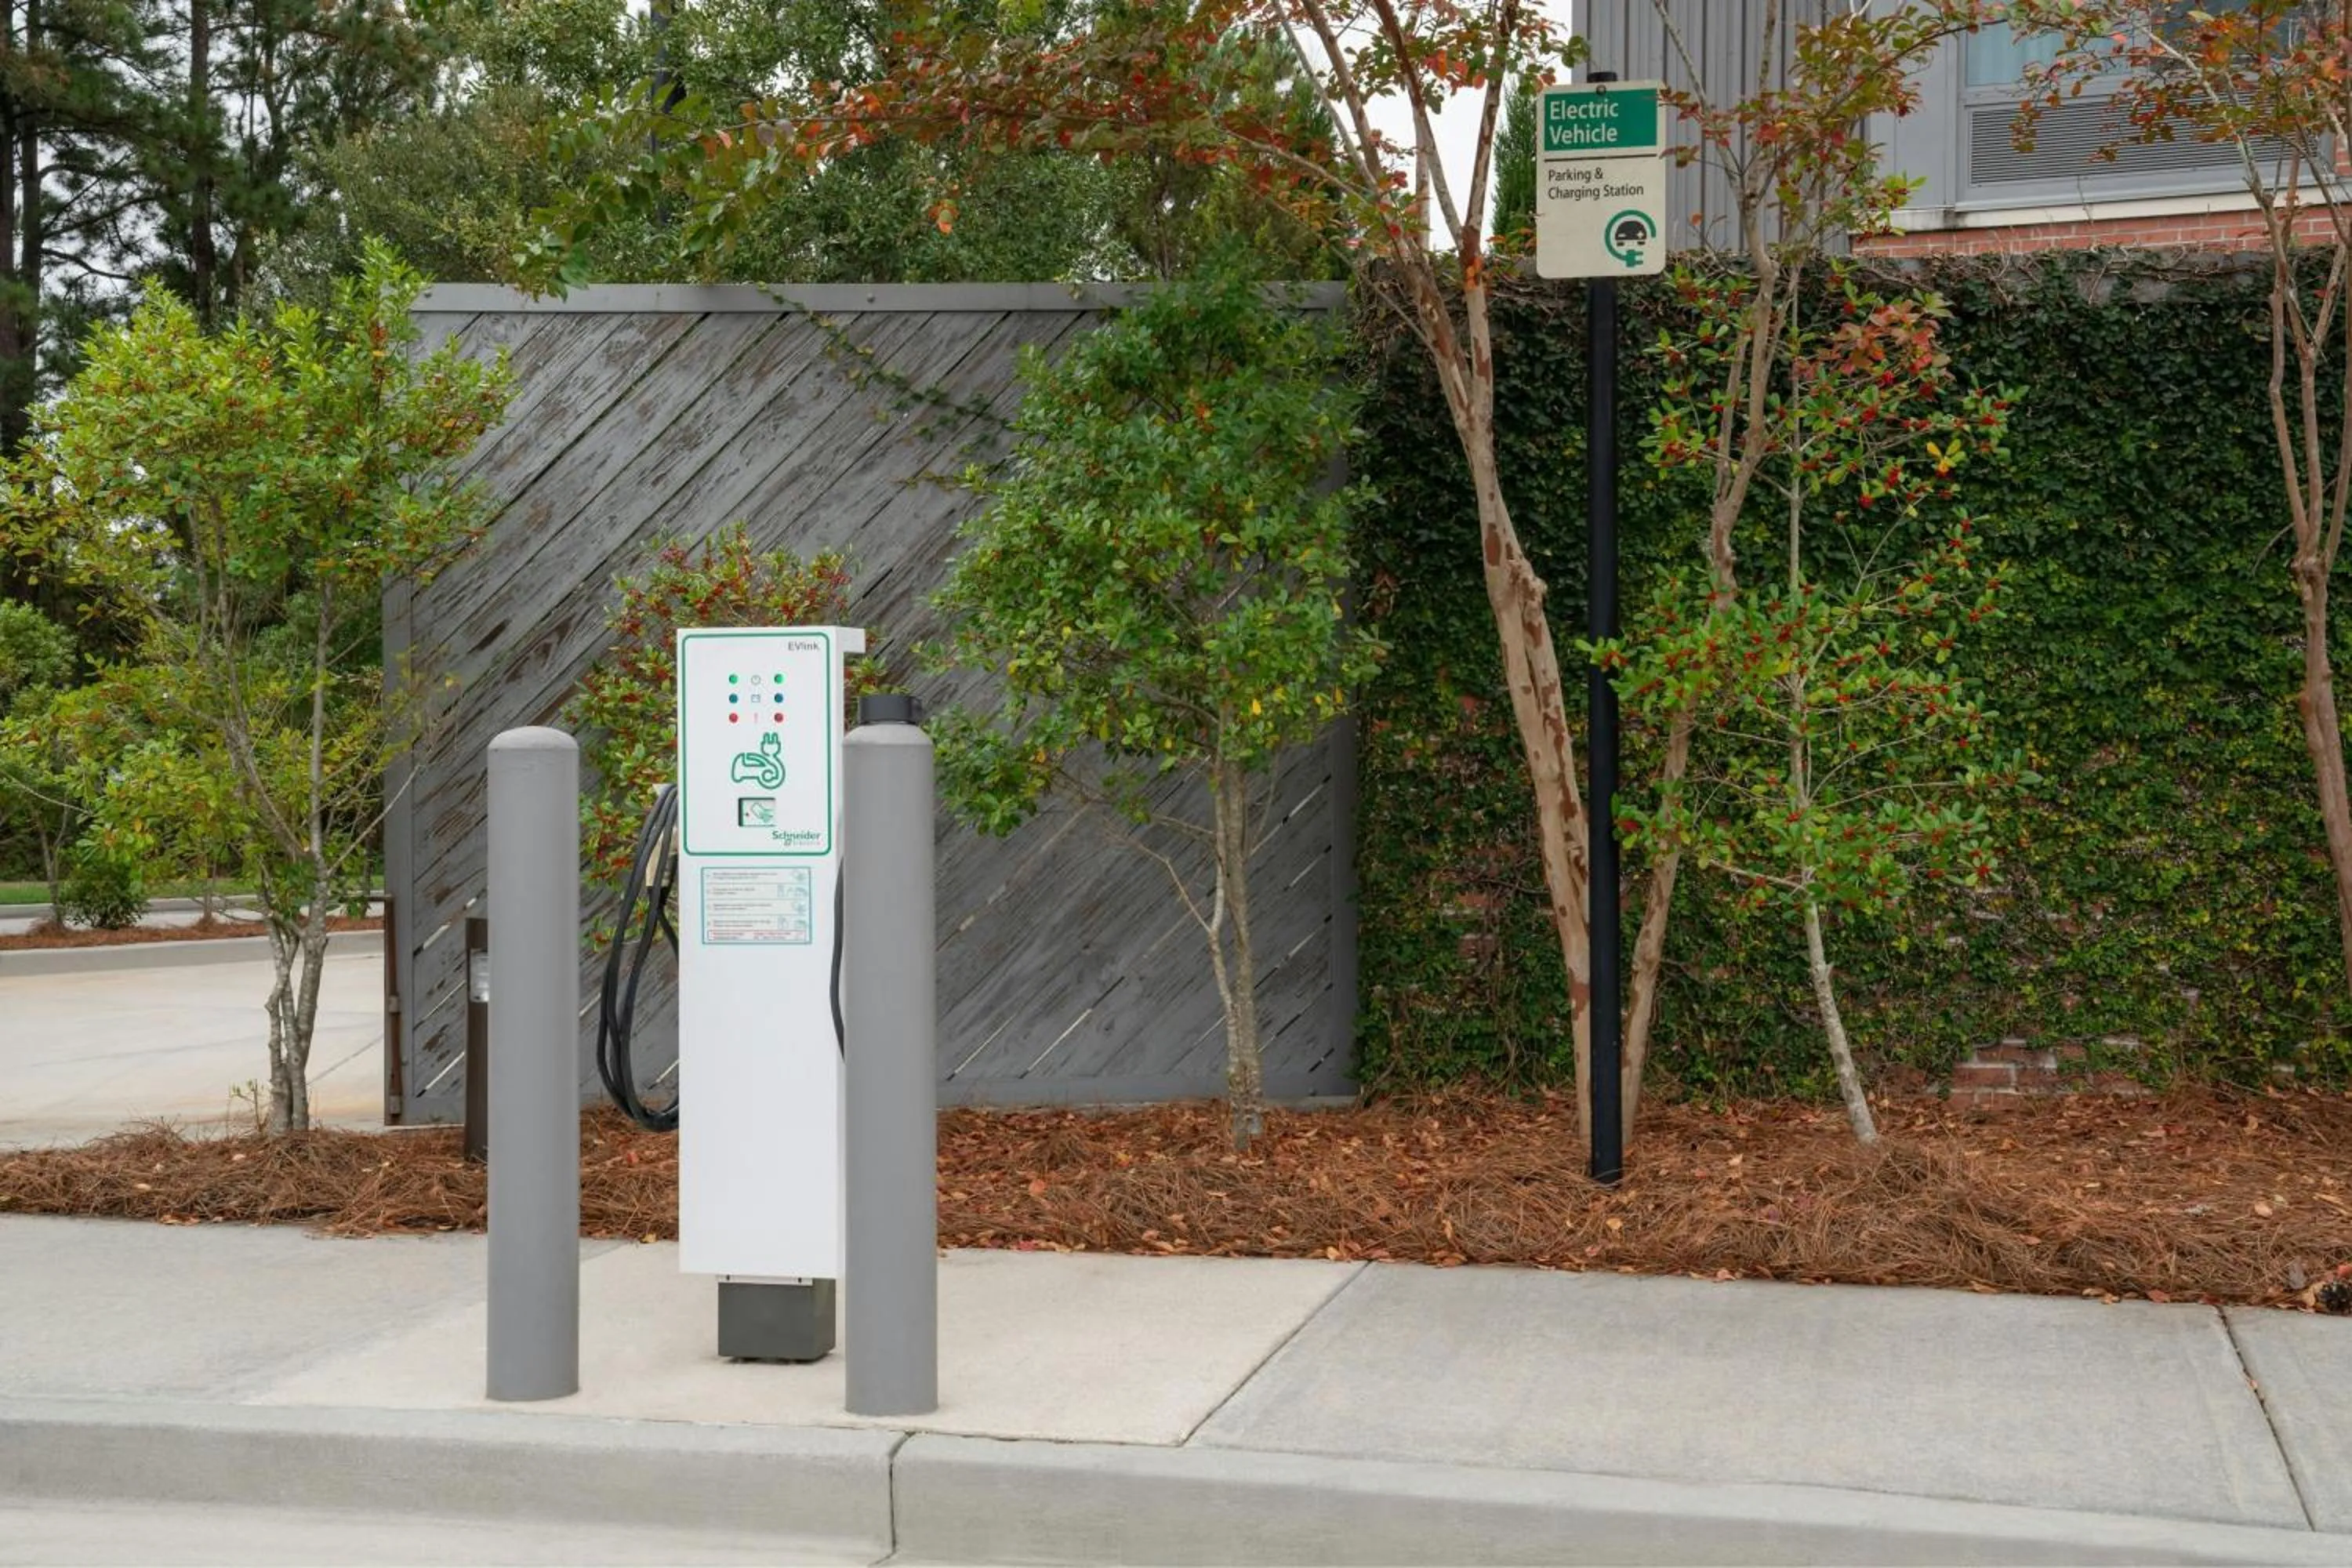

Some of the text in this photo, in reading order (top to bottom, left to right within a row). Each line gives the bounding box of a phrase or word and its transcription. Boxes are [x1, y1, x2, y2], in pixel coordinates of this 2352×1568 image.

[1549, 99, 1619, 121] Electric
[1549, 122, 1618, 145] Vehicle
[1548, 167, 1603, 184] Parking &
[1548, 183, 1644, 201] Charging Station
[771, 830, 821, 841] Schneider
